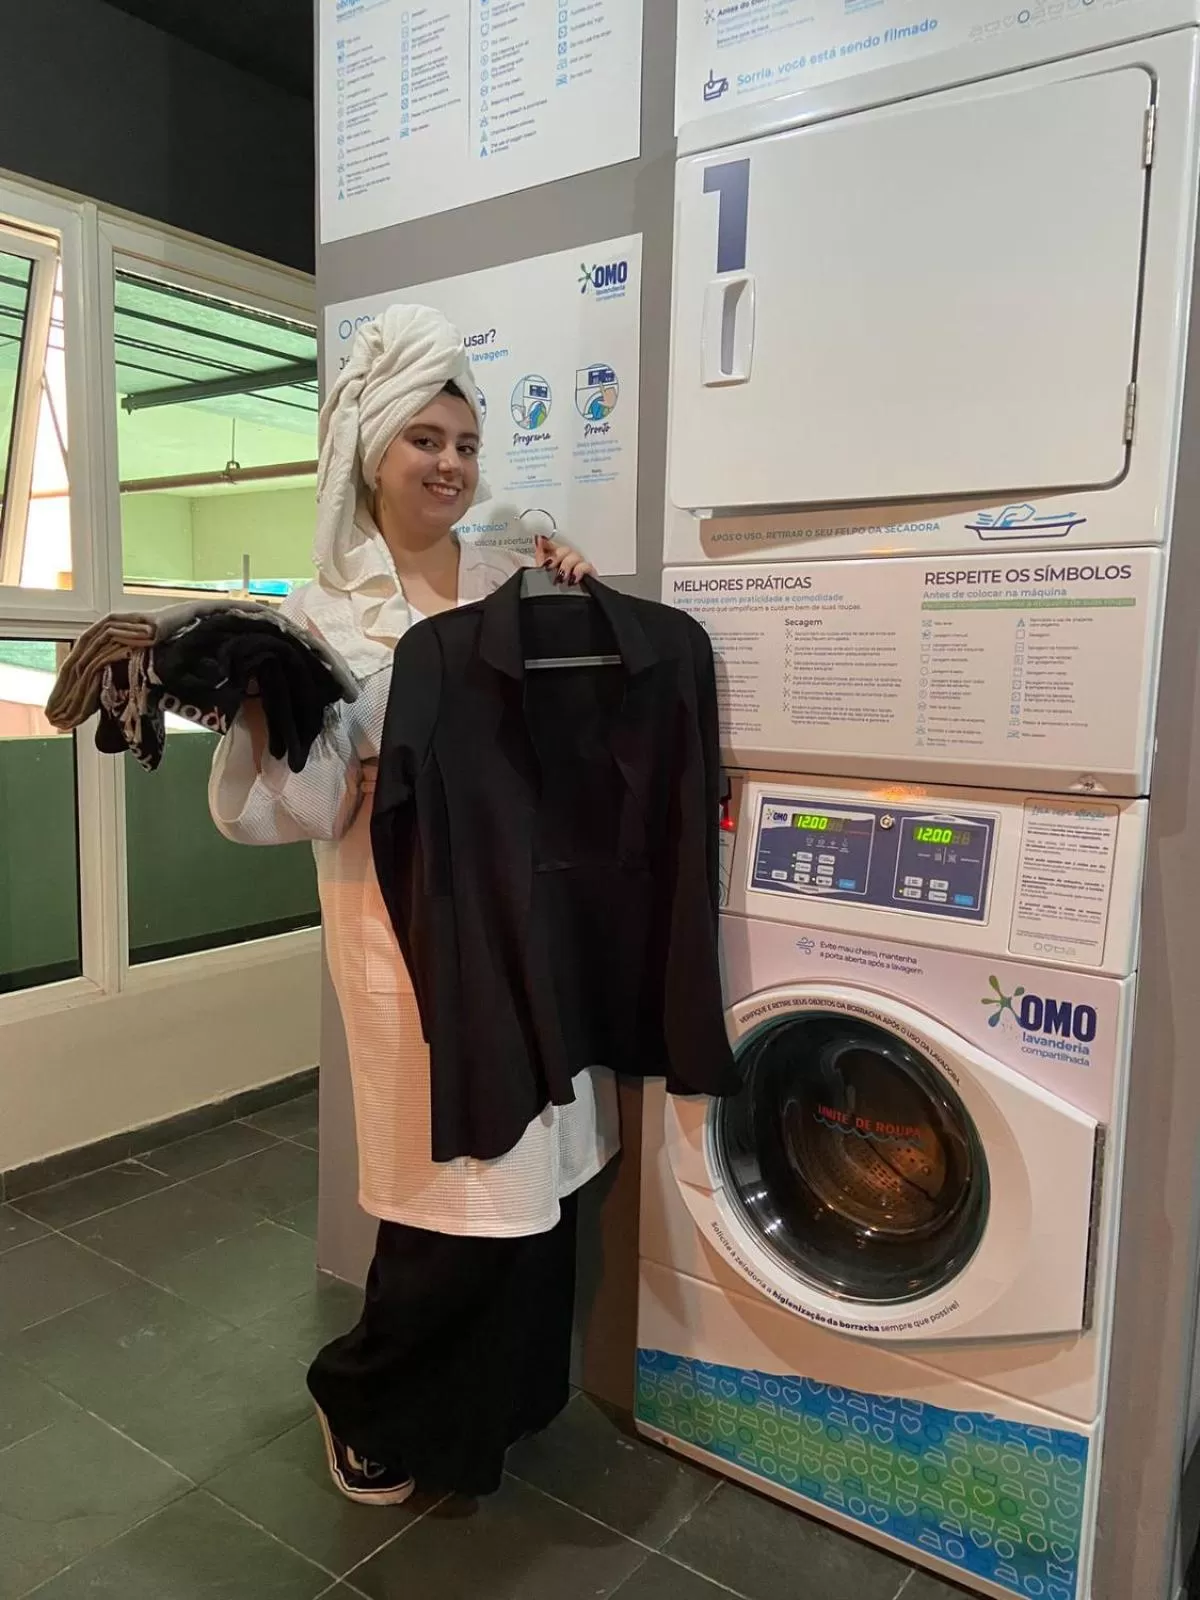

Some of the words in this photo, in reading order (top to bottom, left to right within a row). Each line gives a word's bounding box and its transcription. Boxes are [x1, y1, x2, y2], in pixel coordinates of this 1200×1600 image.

[777, 57, 806, 74] você
[810, 47, 836, 65] está
[840, 35, 880, 56] sendo
[883, 18, 939, 44] filmado
[703, 158, 750, 273] 1
[594, 261, 628, 288] OMO
[464, 329, 496, 347] usar?
[472, 350, 509, 361] lavagem
[513, 432, 551, 446] Programa
[584, 422, 610, 438] Pronto
[766, 529, 804, 539] RETIRAR
[805, 529, 813, 537] O
[815, 528, 833, 537] SEU
[835, 526, 866, 536] FELPO
[868, 525, 882, 534] DA
[885, 522, 940, 533] SECADORA
[673, 579, 743, 592] MELHORES
[746, 574, 812, 590] PRÁTICAS
[925, 570, 1001, 585] RESPEITE
[1005, 568, 1030, 583] OS
[1034, 564, 1131, 583] SÍMBOLOS
[792, 593, 844, 602] comodidade
[923, 591, 950, 600] Antes
[952, 590, 964, 599] de
[966, 589, 1003, 598] colocar
[1021, 588, 1067, 599] máquina
[785, 619, 823, 627] Secagem
[773, 812, 788, 821] OMO
[820, 941, 837, 950] Evite
[838, 945, 854, 953] mau
[879, 953, 917, 965] mantenha
[825, 952, 844, 961] porta
[845, 955, 866, 965] aberta
[868, 959, 884, 969] após
[891, 963, 923, 975] lavagem
[1020, 994, 1097, 1043] OMO
[739, 1005, 766, 1023] VERIFIQUE
[772, 1000, 792, 1009] RETIRE
[808, 998, 836, 1008] OBJETOS
[837, 1002, 846, 1010] DA
[847, 1004, 881, 1021] BORRACHA
[882, 1016, 900, 1031] APÓS
[907, 1031, 921, 1044] USO
[920, 1042, 930, 1053] DA
[929, 1050, 960, 1085] LAVADORA
[1022, 1032, 1089, 1055] lavanderia
[1021, 1046, 1090, 1067] compartilhada
[855, 1117, 871, 1130] DE
[876, 1121, 921, 1137] ROUPA
[711, 1221, 732, 1251] Solicite
[735, 1256, 767, 1290] zeladoria
[772, 1290, 826, 1324] higienização
[826, 1317, 838, 1326] da
[839, 1321, 879, 1332] borracha
[881, 1322, 913, 1332] sempre
[914, 1318, 929, 1328] que
[929, 1300, 960, 1324] possível
